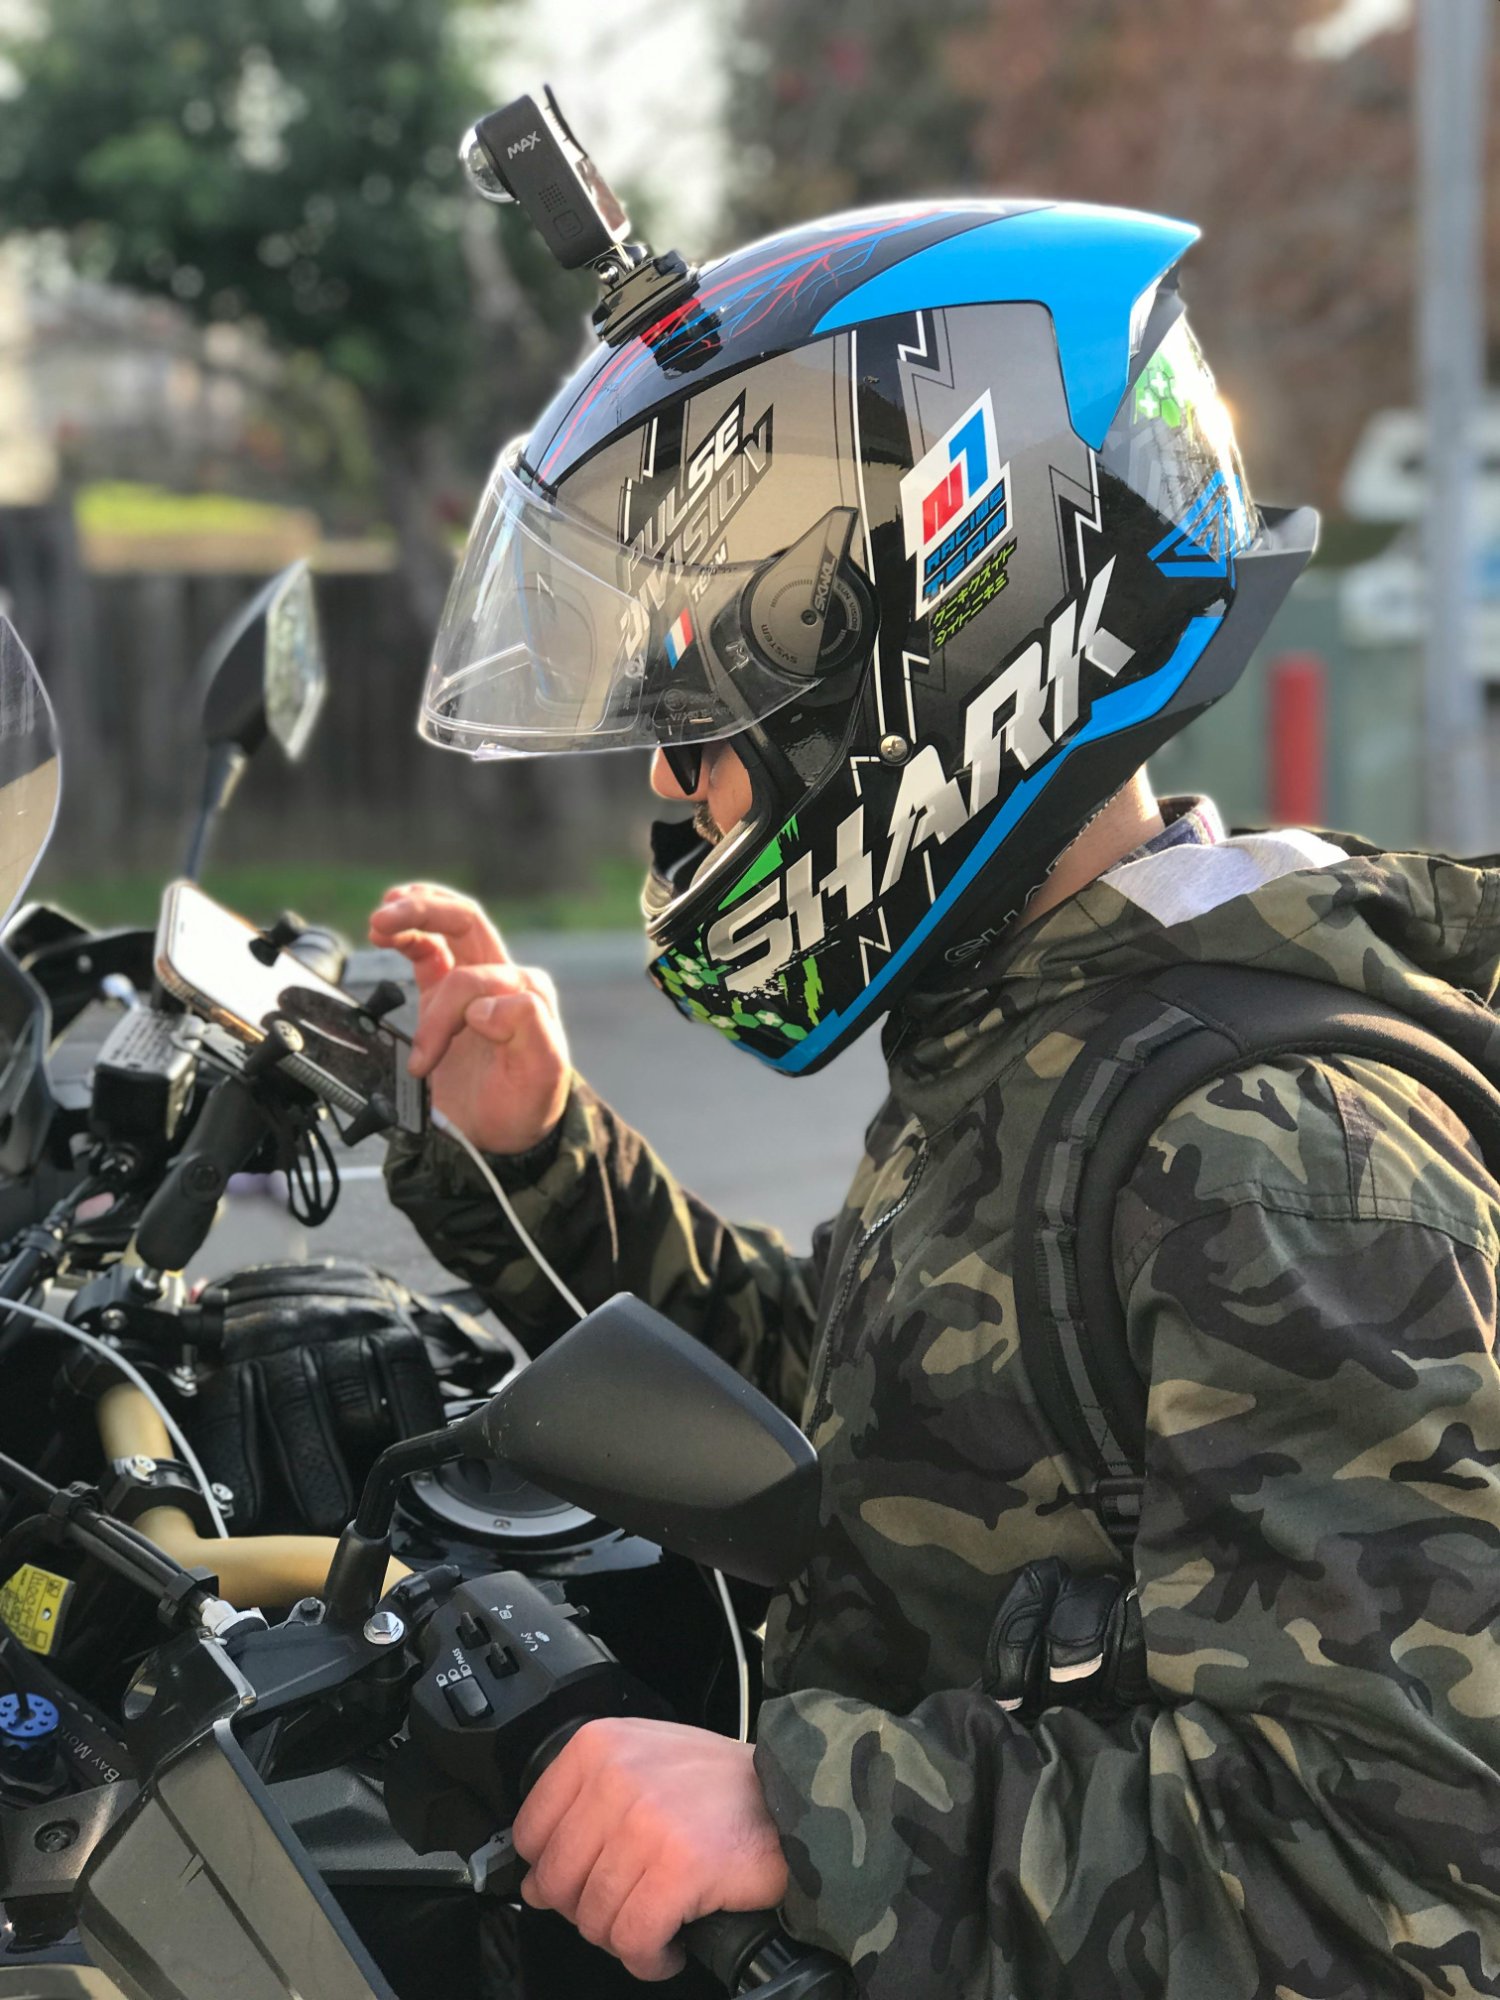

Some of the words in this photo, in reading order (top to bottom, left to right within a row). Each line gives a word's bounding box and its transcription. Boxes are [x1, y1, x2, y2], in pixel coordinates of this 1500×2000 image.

[507, 131, 541, 159] MAX
[620, 416, 769, 660] DIVISION
[625, 403, 740, 594] PULSE
[925, 482, 1005, 575] RACING
[814, 558, 837, 612] SKWAL
[923, 507, 1007, 601] TEAM
[706, 555, 1137, 995] SHARK
[453, 1648, 465, 1664] PASS
